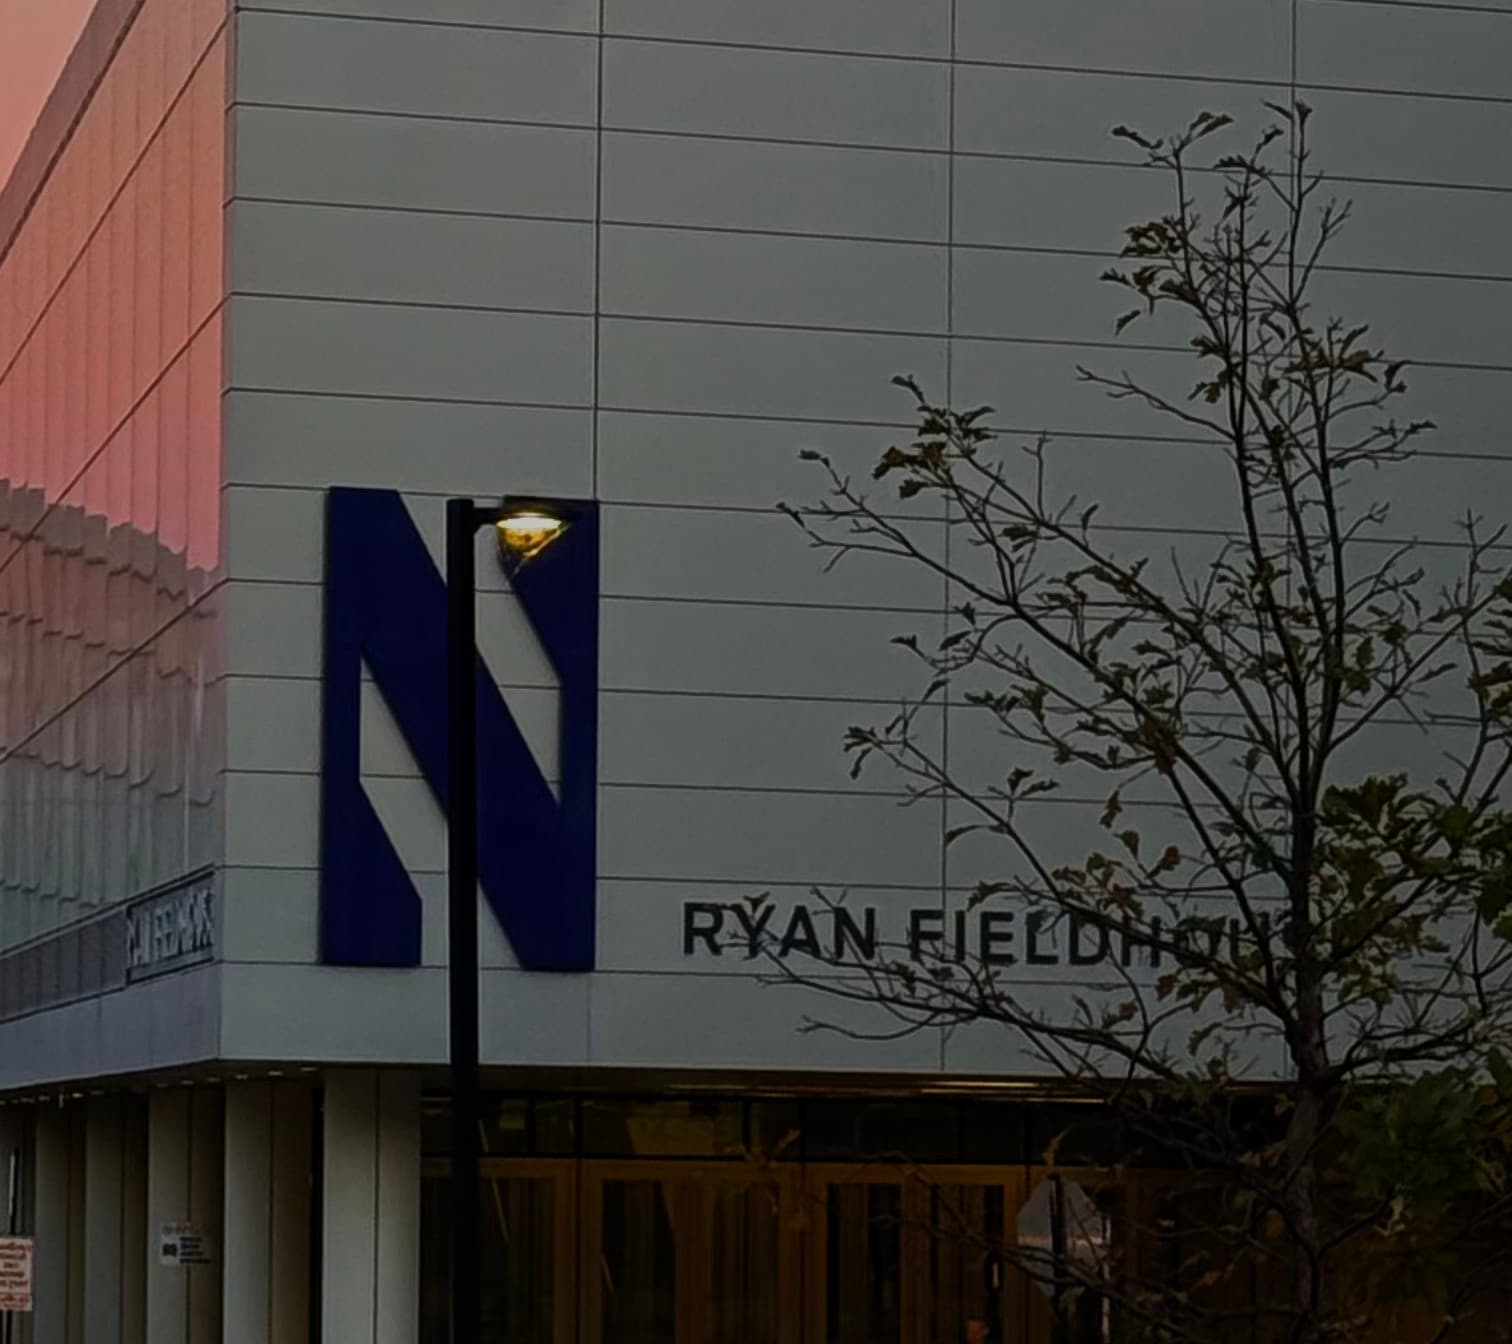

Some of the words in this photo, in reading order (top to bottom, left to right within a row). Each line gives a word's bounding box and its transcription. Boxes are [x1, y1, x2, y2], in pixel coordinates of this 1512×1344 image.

[322, 486, 598, 972] N
[683, 900, 877, 961] RYAN
[909, 908, 1352, 973] FIELDHOU
